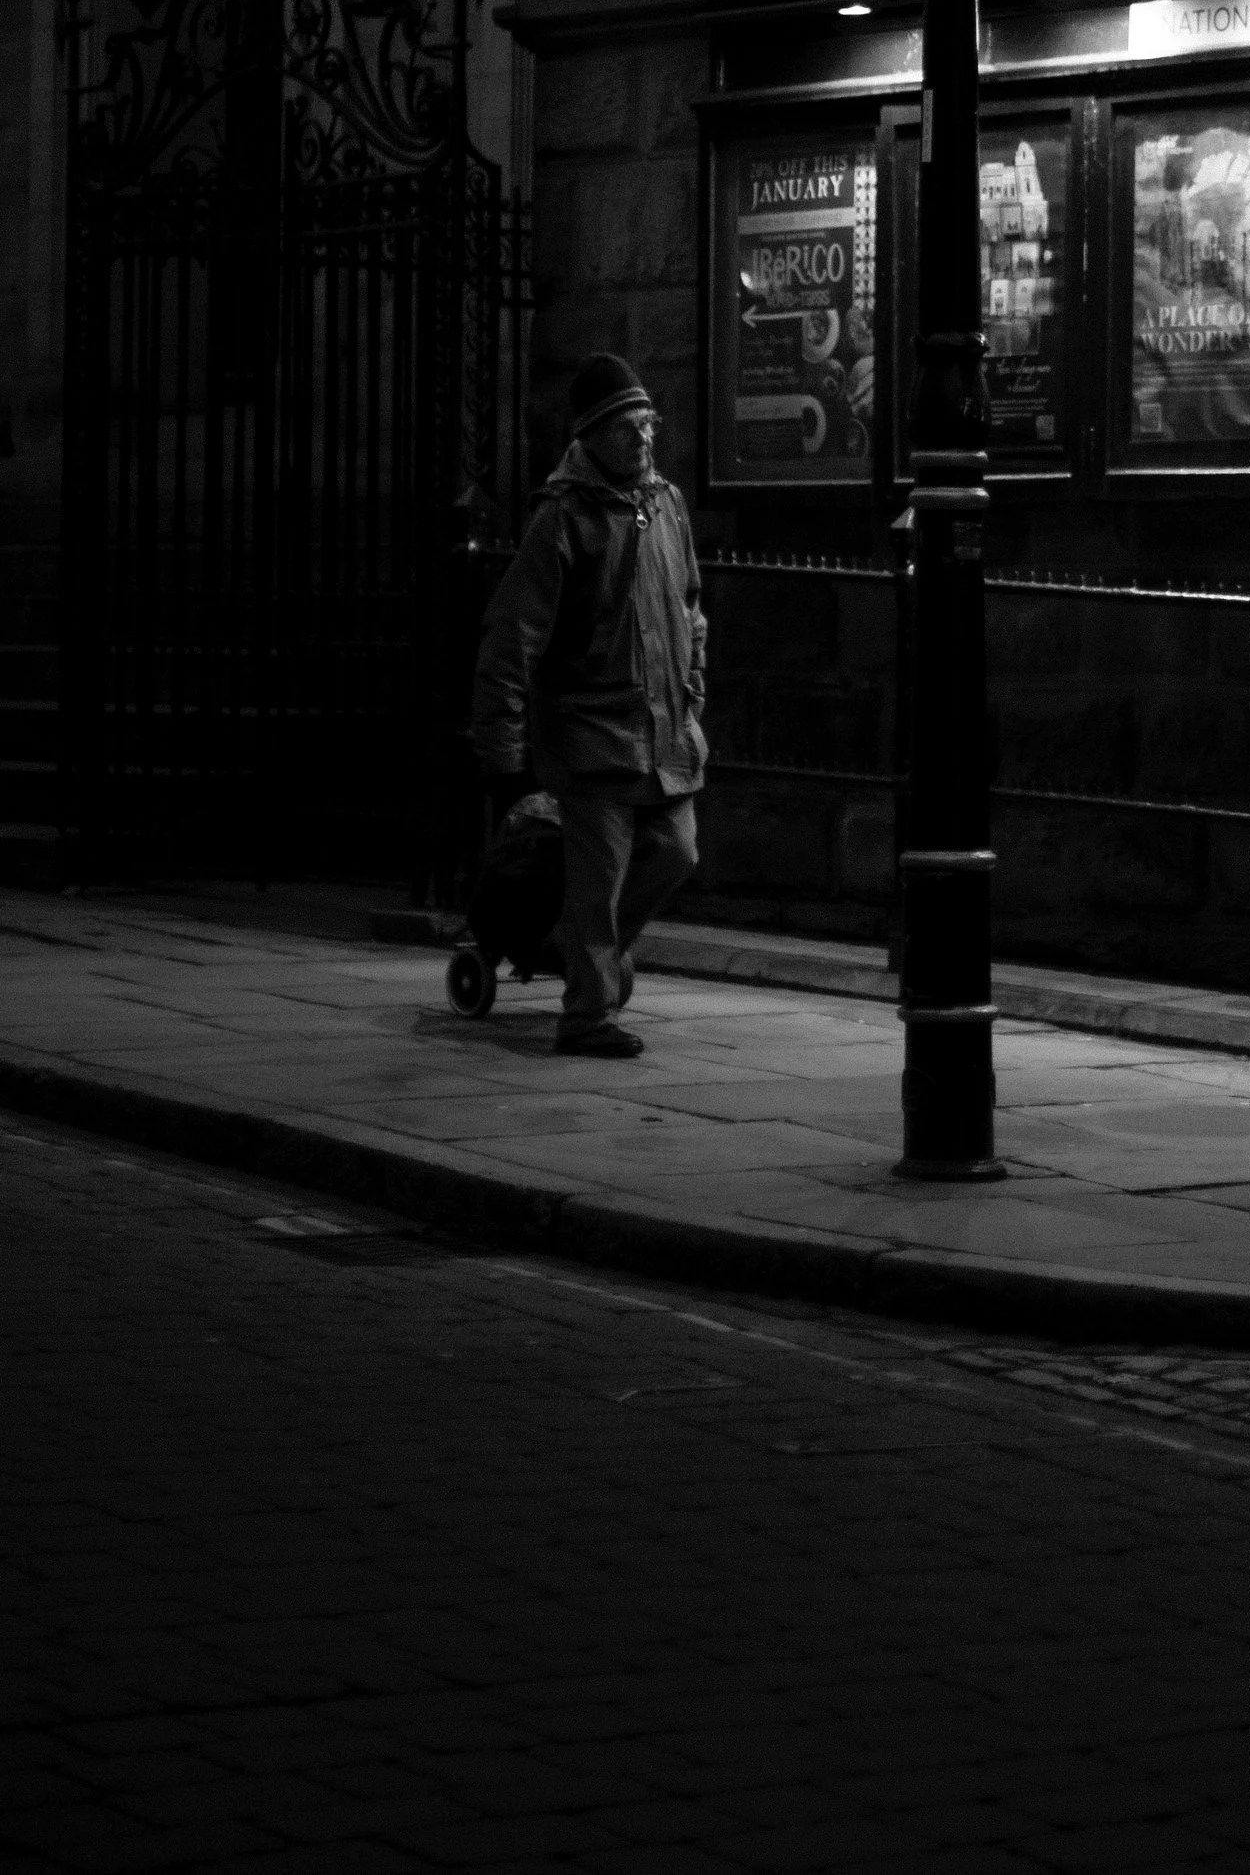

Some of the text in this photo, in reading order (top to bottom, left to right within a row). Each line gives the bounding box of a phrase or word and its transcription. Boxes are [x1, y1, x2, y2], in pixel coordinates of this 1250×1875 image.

[778, 157, 807, 177] OFF
[813, 153, 849, 174] THIS
[750, 174, 845, 211] JANUARY
[1140, 307, 1156, 329] A
[1158, 303, 1225, 327] PLACE
[1140, 330, 1236, 354] WONDER
